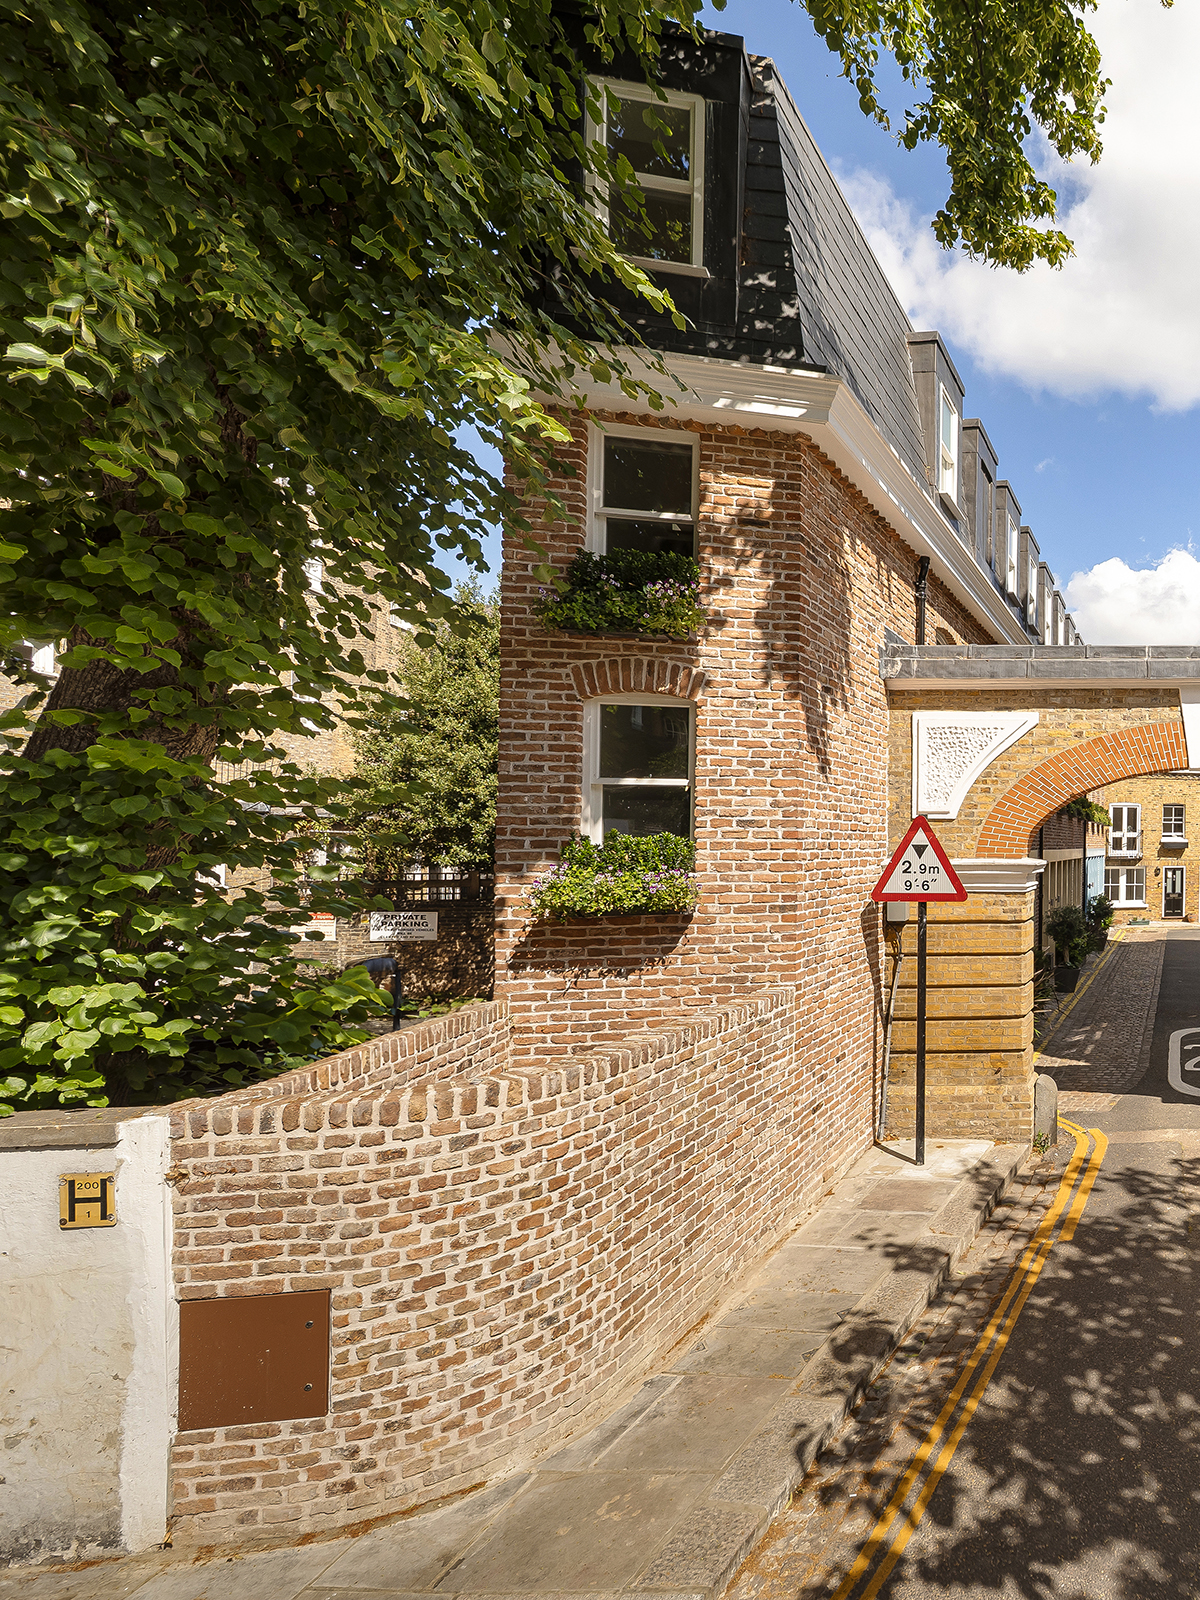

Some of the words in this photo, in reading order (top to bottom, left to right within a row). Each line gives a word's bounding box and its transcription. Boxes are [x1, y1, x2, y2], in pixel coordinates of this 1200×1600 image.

[901, 860, 940, 874] 2.9m
[76, 1181, 99, 1190] 200
[68, 1178, 108, 1222] H
[86, 1210, 91, 1218] 1
